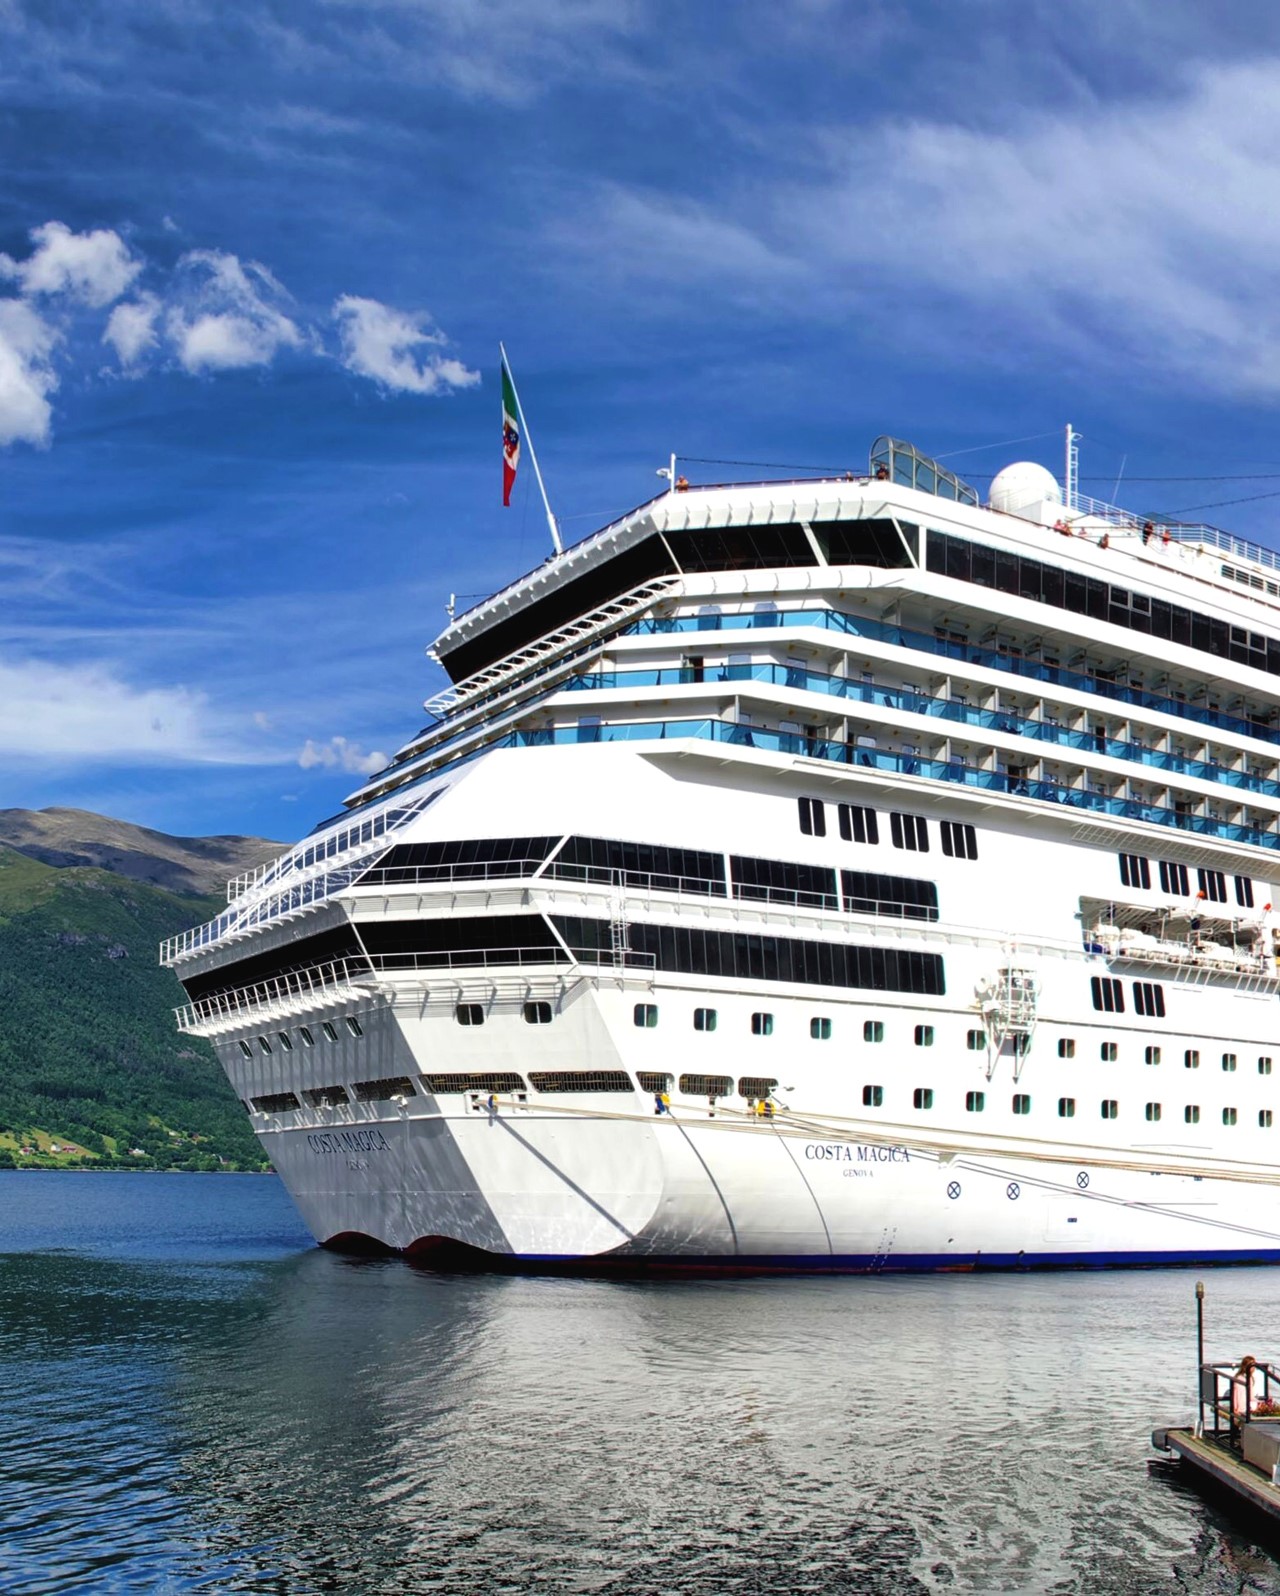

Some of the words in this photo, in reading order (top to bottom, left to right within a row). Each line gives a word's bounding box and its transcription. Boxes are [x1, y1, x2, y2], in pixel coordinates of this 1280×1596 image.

[307, 1133, 346, 1154] COSTA
[341, 1129, 392, 1153] MAGICA
[805, 1144, 853, 1162] COSTA
[857, 1145, 911, 1163] MAGICA
[842, 1168, 874, 1178] GENOVA
